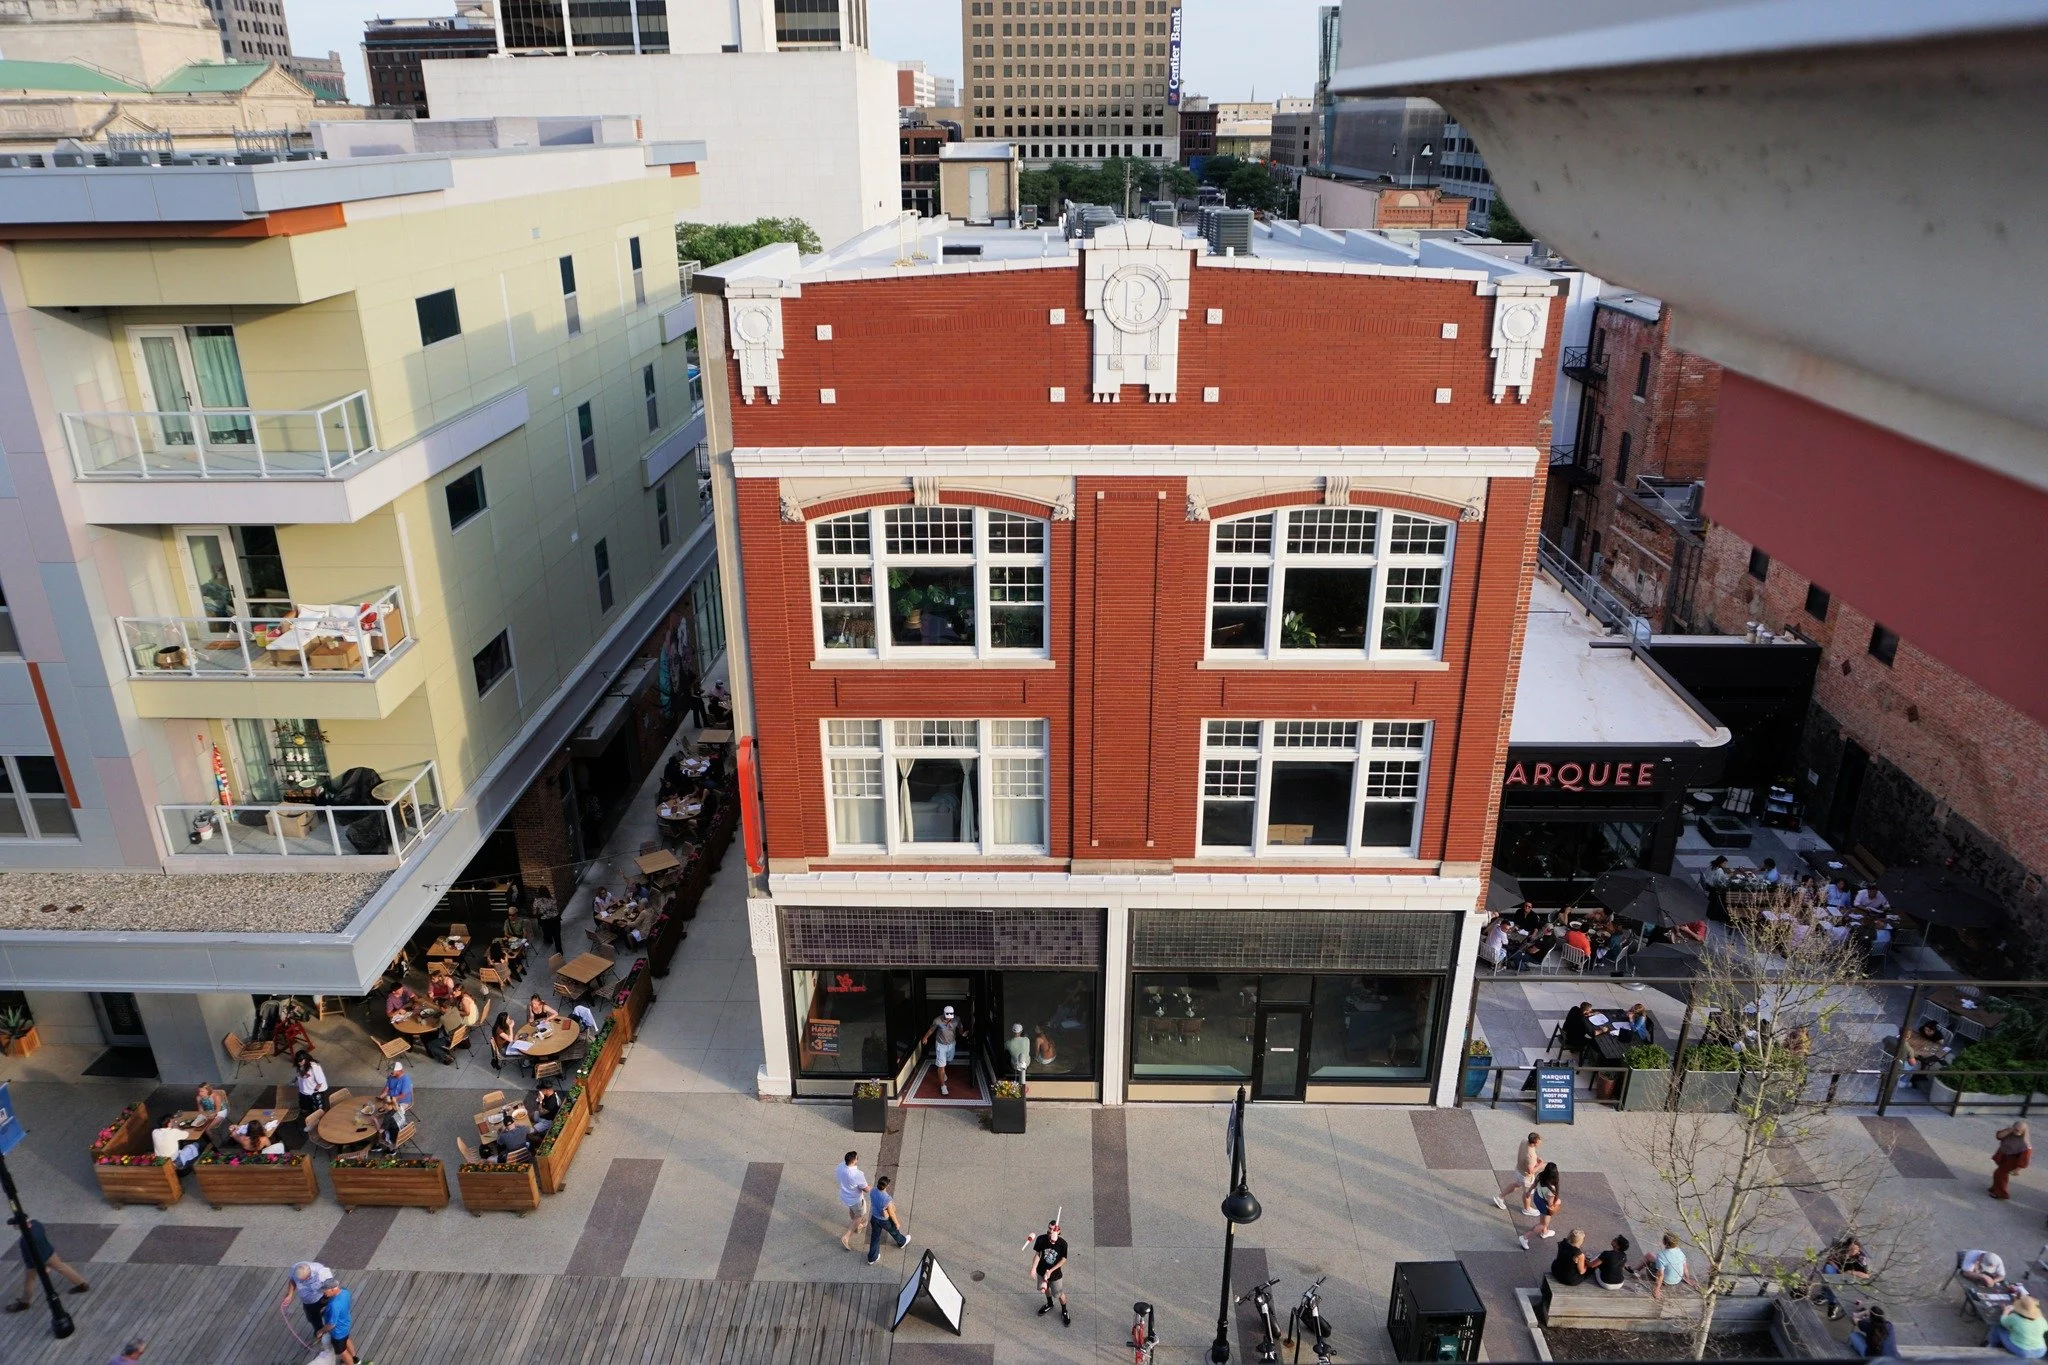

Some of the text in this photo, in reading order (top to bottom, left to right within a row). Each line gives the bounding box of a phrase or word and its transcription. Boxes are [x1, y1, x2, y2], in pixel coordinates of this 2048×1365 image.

[1169, 8, 1181, 89] Centier Bank
[1506, 762, 1656, 791] ARQUEE
